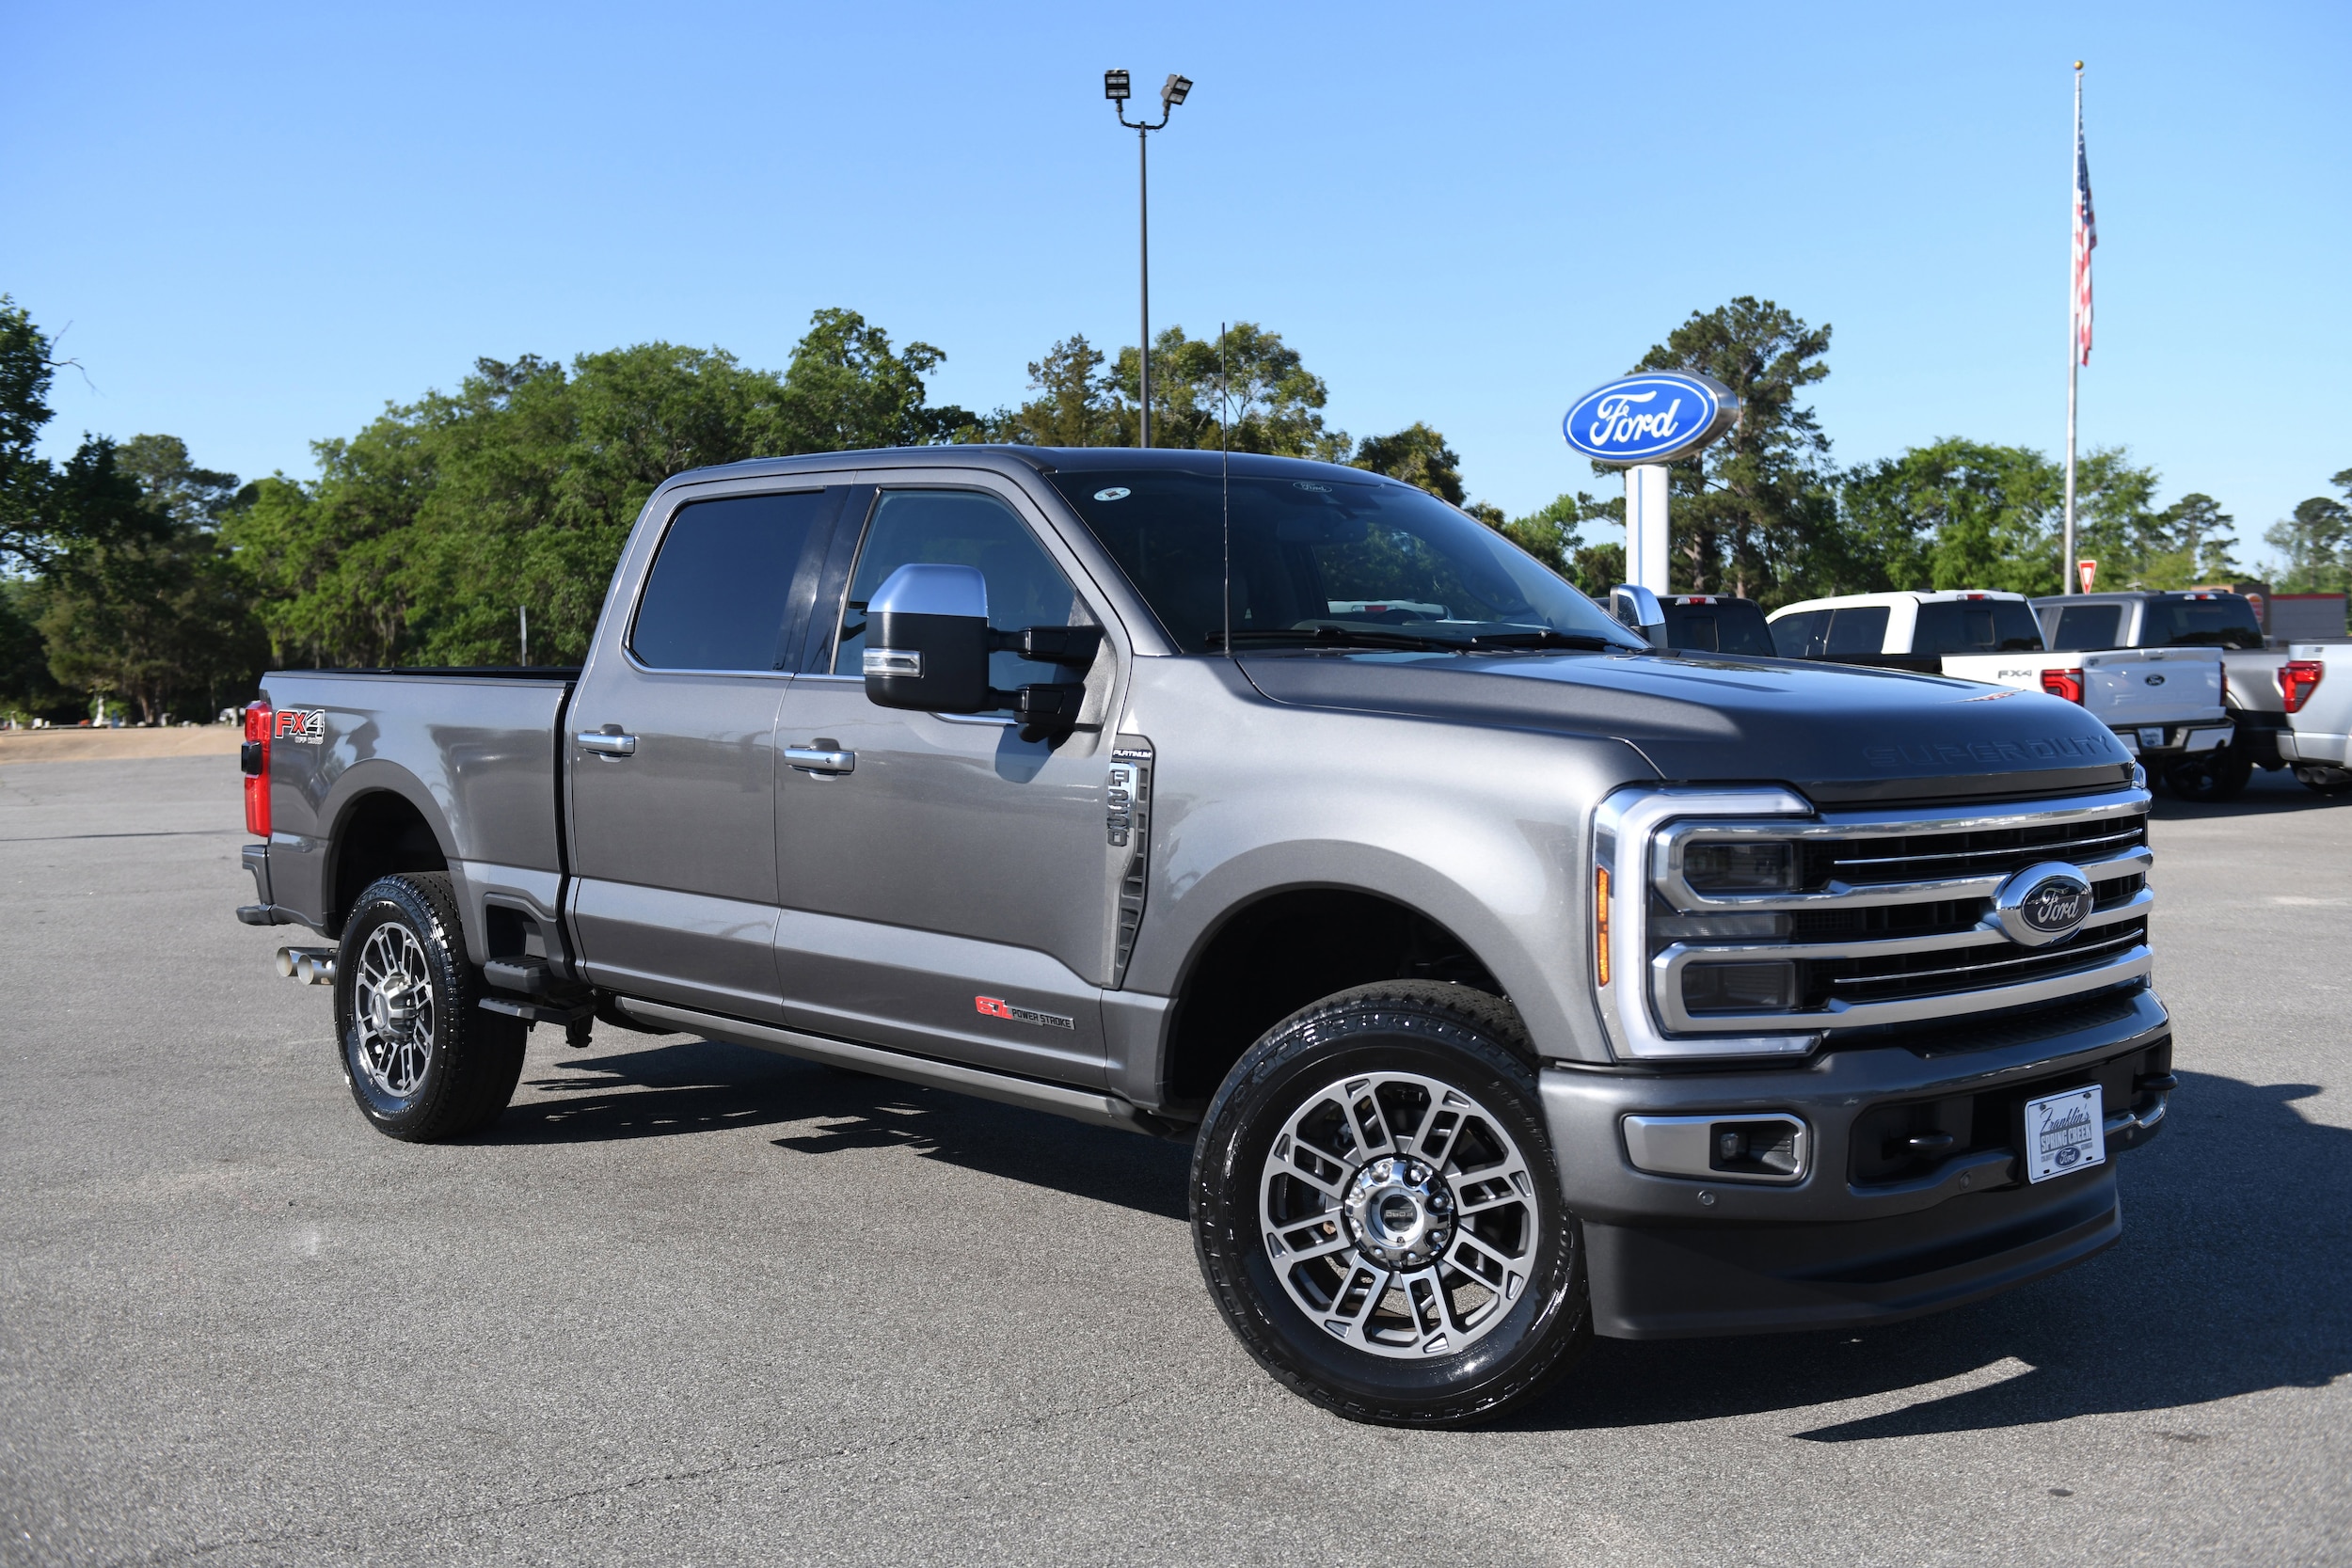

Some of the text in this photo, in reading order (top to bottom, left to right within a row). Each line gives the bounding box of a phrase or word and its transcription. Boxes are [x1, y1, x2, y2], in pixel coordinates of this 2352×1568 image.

[1589, 390, 1681, 446] Ford
[1997, 669, 2032, 679] FX4
[275, 709, 326, 739] FX4
[1113, 750, 1152, 758] PLATINUM
[1863, 739, 2027, 768] SUPER
[2028, 735, 2114, 760] DUTY
[2037, 887, 2079, 923] Ford
[1011, 1008, 1039, 1022] POWER
[1040, 1014, 1072, 1029] STROKE
[2040, 1103, 2090, 1133] Franklin's
[2041, 1130, 2067, 1152] SPRING
[2068, 1123, 2091, 1145] CREEK
[2060, 1148, 2076, 1164] Ford
